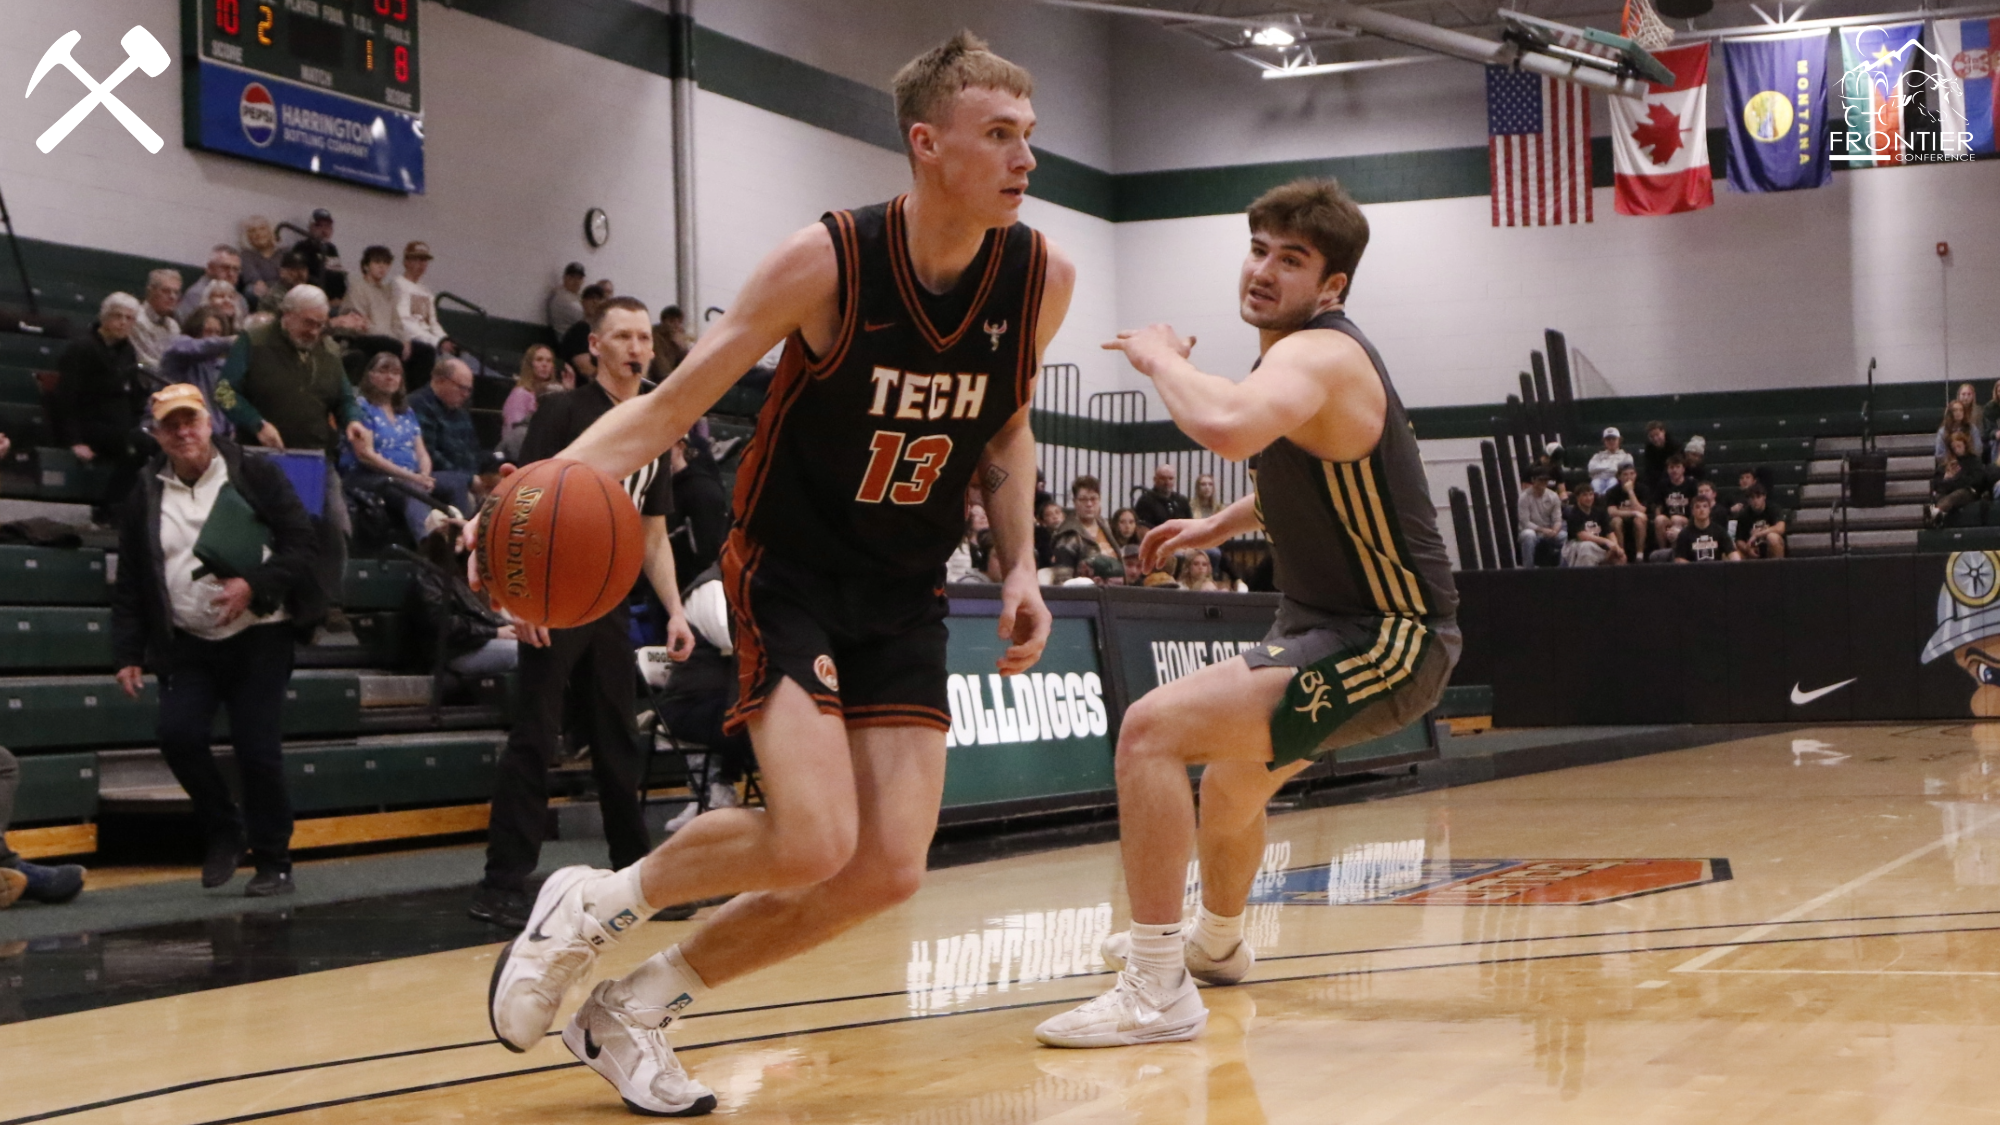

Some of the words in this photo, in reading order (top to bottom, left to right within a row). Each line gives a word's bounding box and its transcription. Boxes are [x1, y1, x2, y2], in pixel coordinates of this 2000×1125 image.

[257, 5, 274, 45] 2
[211, 39, 243, 64] SCORE
[366, 39, 374, 71] 1
[394, 45, 409, 83] 8
[243, 104, 274, 124] PEPSI
[281, 103, 374, 145] HARRINGTON
[1796, 59, 1810, 165] MONTANA
[283, 127, 325, 150] BOTTLING
[326, 137, 369, 158] COMPANY
[867, 365, 989, 421] TECH
[854, 429, 954, 505] 13
[506, 485, 544, 598] SPALDING
[1151, 640, 1208, 687] HOME
[946, 671, 1108, 748] OLLDIGGS
